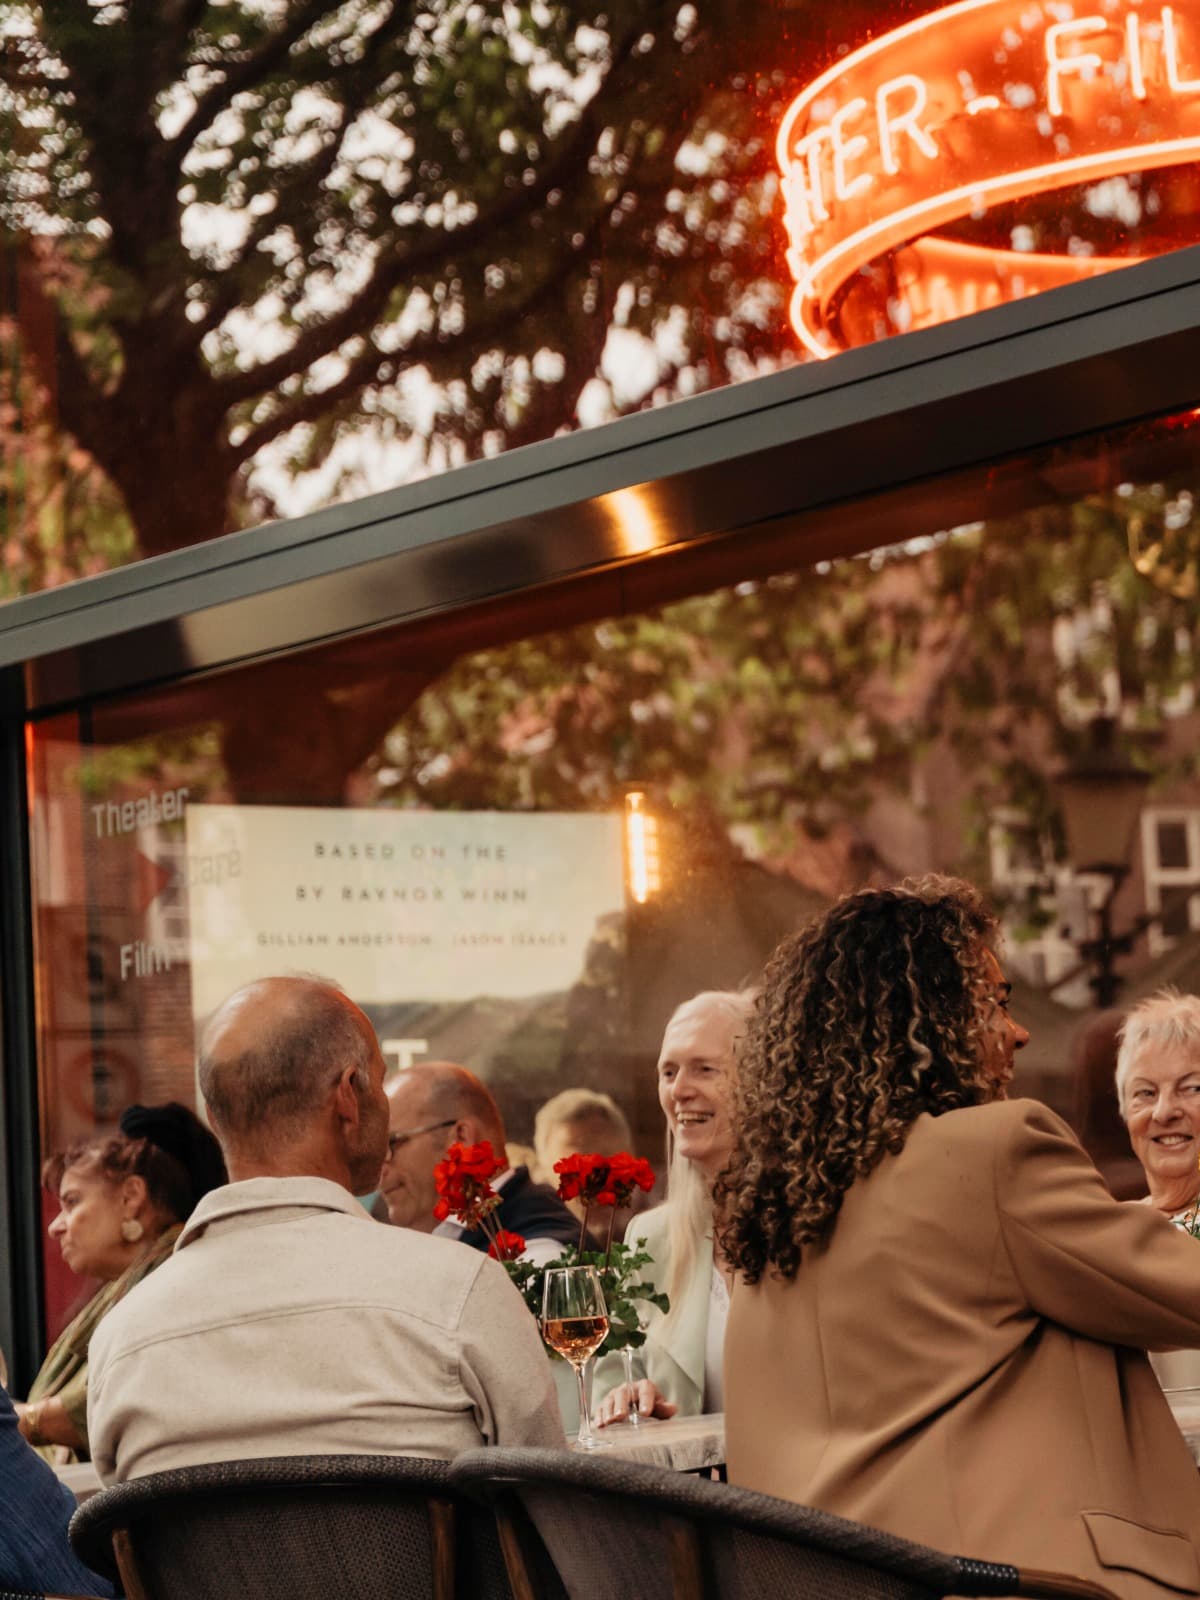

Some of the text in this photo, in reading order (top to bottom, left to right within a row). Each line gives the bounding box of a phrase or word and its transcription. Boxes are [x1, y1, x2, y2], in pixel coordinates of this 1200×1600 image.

[91, 787, 189, 838] Theater
[314, 842, 506, 862] BASED ON THE
[295, 885, 528, 902] BY RAYNOR WINN
[119, 939, 171, 981] Film
